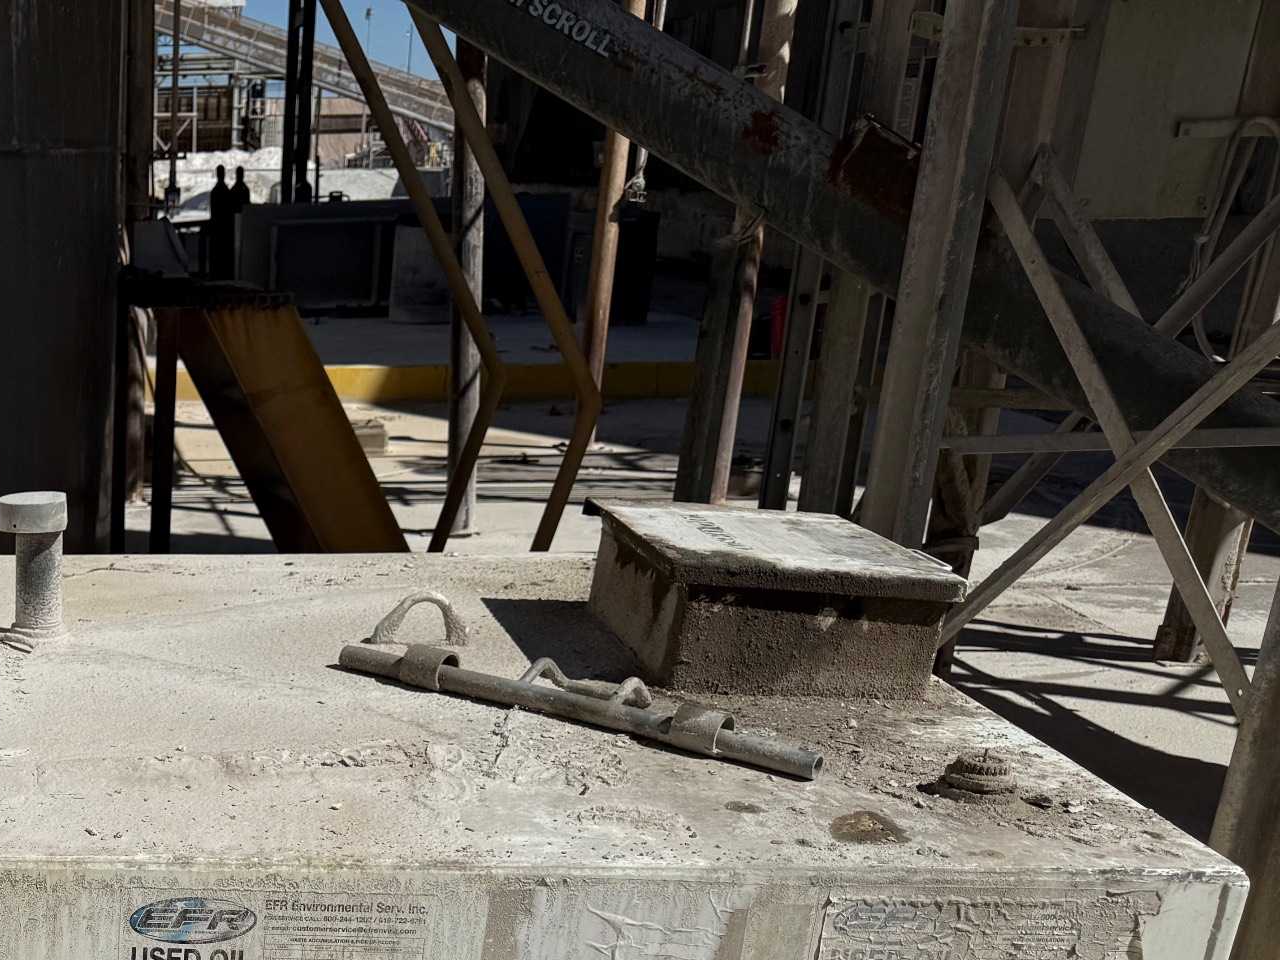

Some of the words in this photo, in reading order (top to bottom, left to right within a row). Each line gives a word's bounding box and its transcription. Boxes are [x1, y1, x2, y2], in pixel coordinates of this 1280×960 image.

[527, 0, 611, 58] SCROLL
[265, 900, 288, 911] EFR
[291, 901, 374, 913] Environmental
[135, 908, 251, 930] EFR
